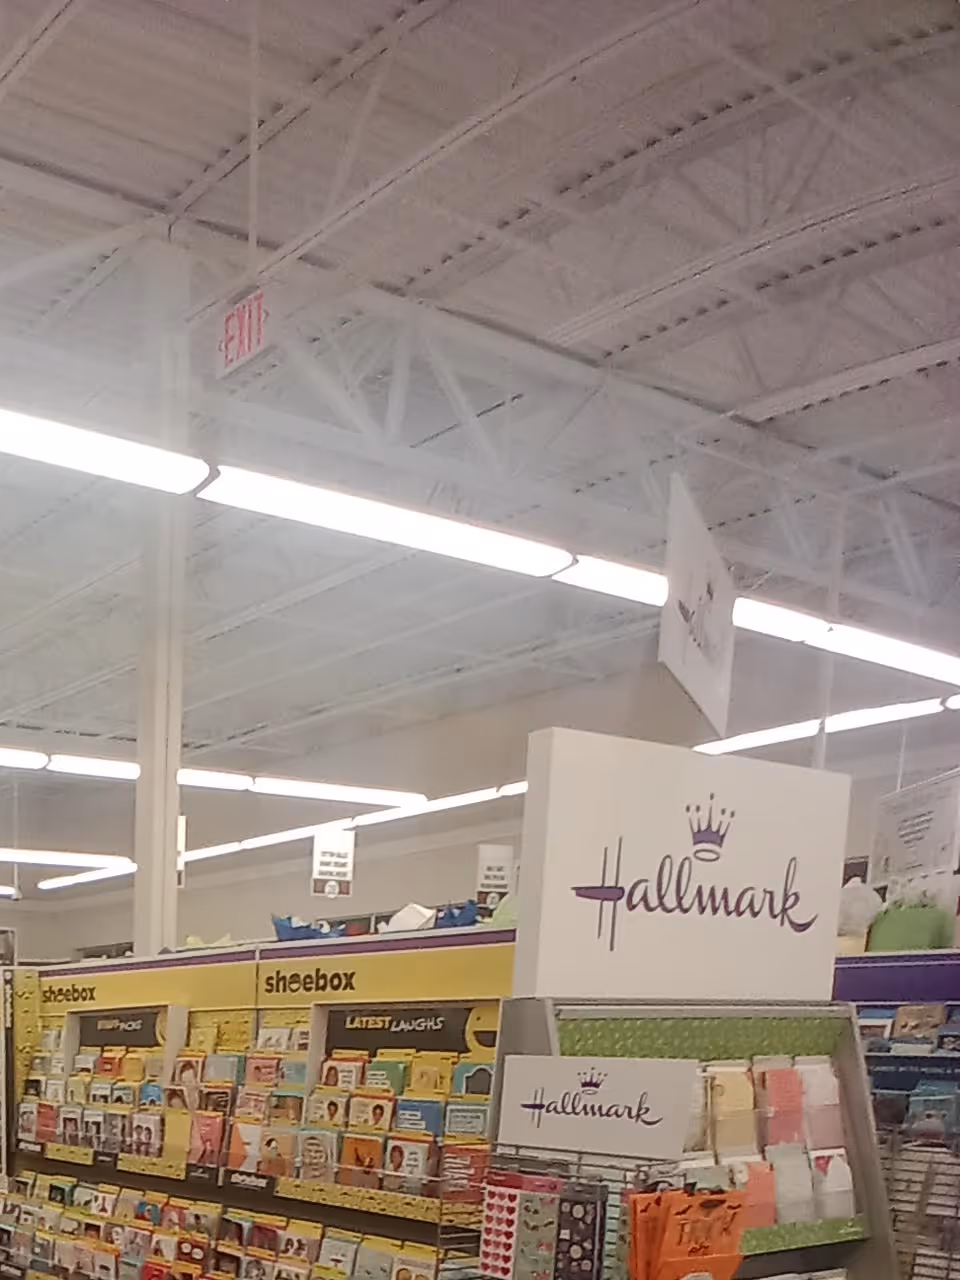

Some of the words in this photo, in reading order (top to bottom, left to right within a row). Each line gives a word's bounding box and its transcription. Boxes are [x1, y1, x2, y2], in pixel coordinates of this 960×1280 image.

[224, 290, 263, 368] EXIT
[570, 836, 819, 952] Hallmark
[43, 984, 96, 1004] shoebox
[265, 968, 356, 994] shoebox
[345, 1016, 391, 1030] LATEST
[391, 1016, 446, 1033] LAUGHS
[520, 1087, 664, 1129] Hallmark
